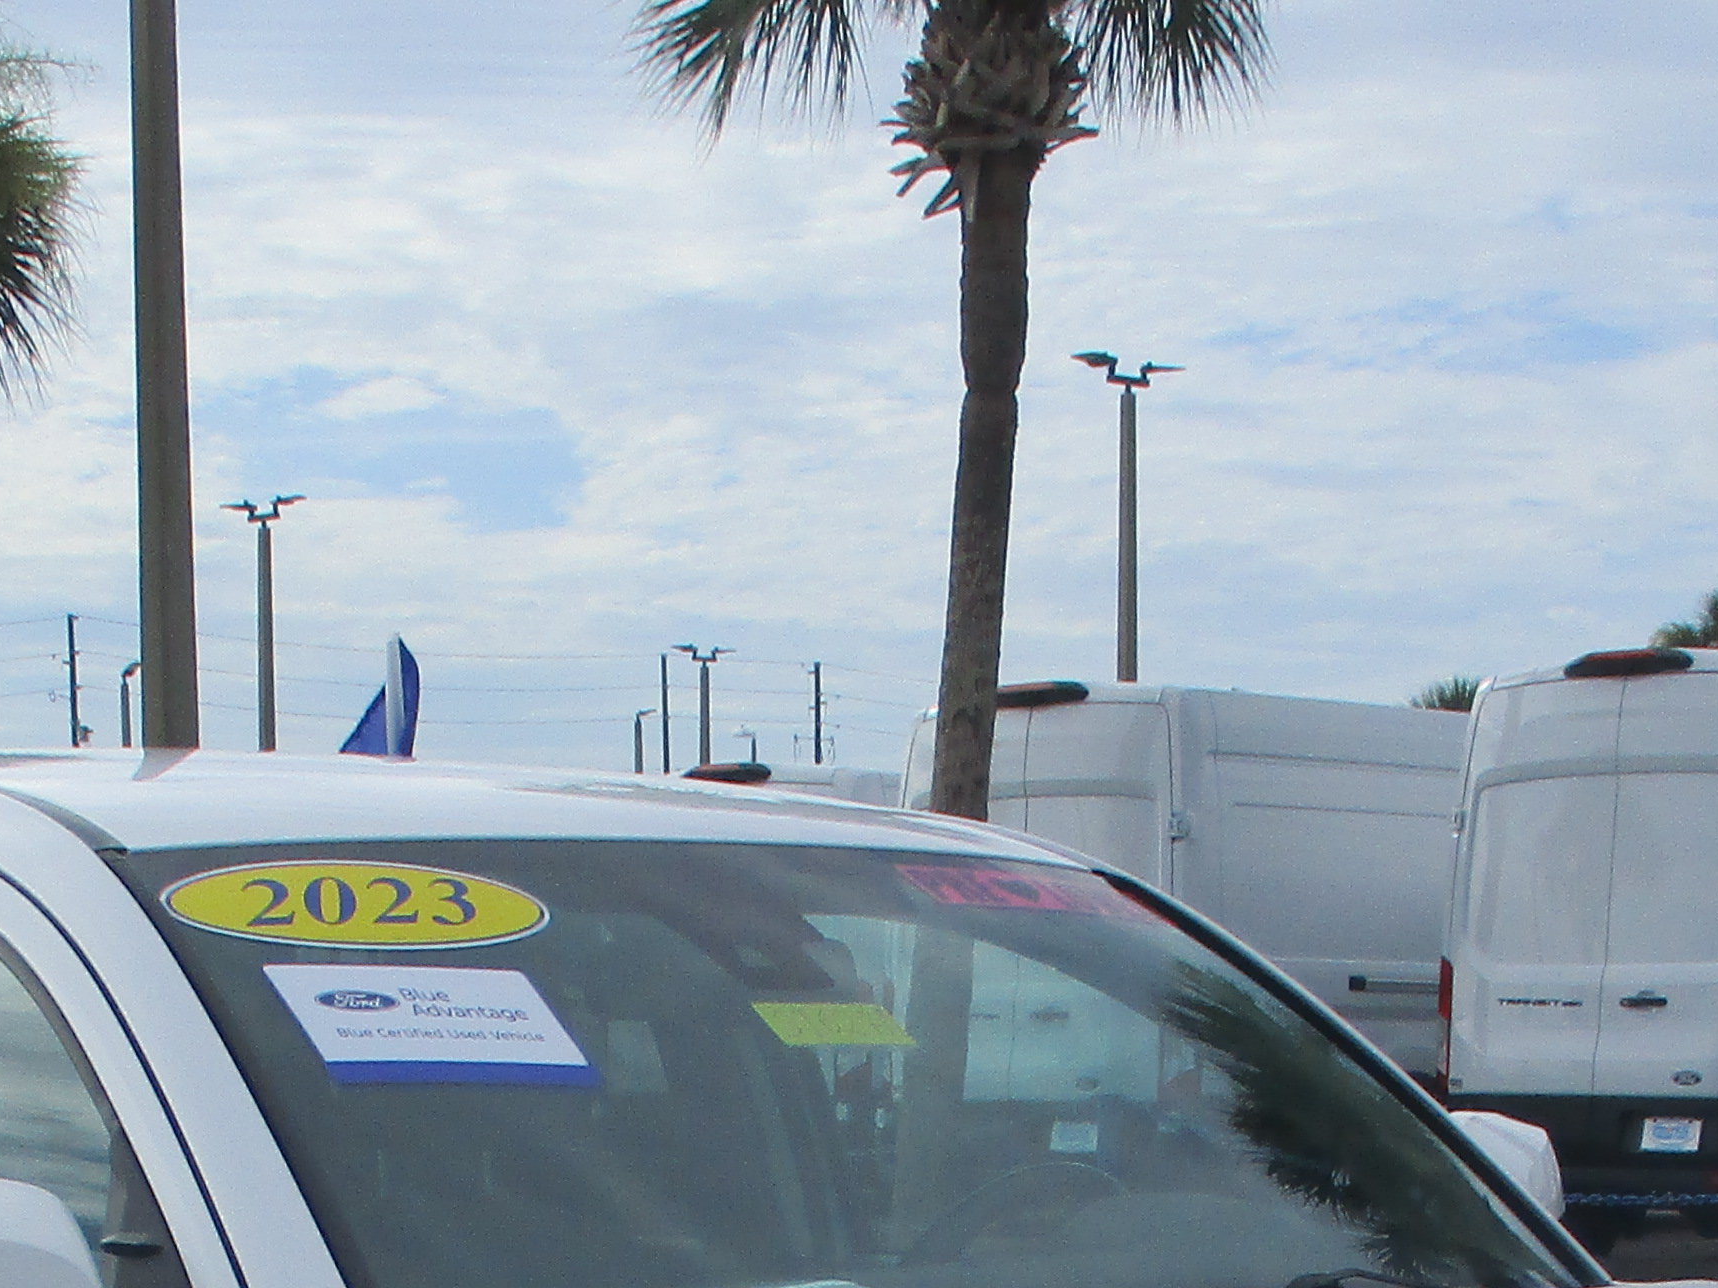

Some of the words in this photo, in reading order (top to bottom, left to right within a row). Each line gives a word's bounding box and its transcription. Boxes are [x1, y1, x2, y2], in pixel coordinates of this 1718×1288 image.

[242, 877, 477, 926] 2023
[329, 989, 383, 1010] Ford
[398, 987, 450, 1003] Blue
[413, 1004, 529, 1023] Advantage
[337, 1028, 373, 1039] Blue
[377, 1028, 441, 1040] Certified
[446, 1029, 485, 1040] Used
[489, 1030, 545, 1042] Vehicle
